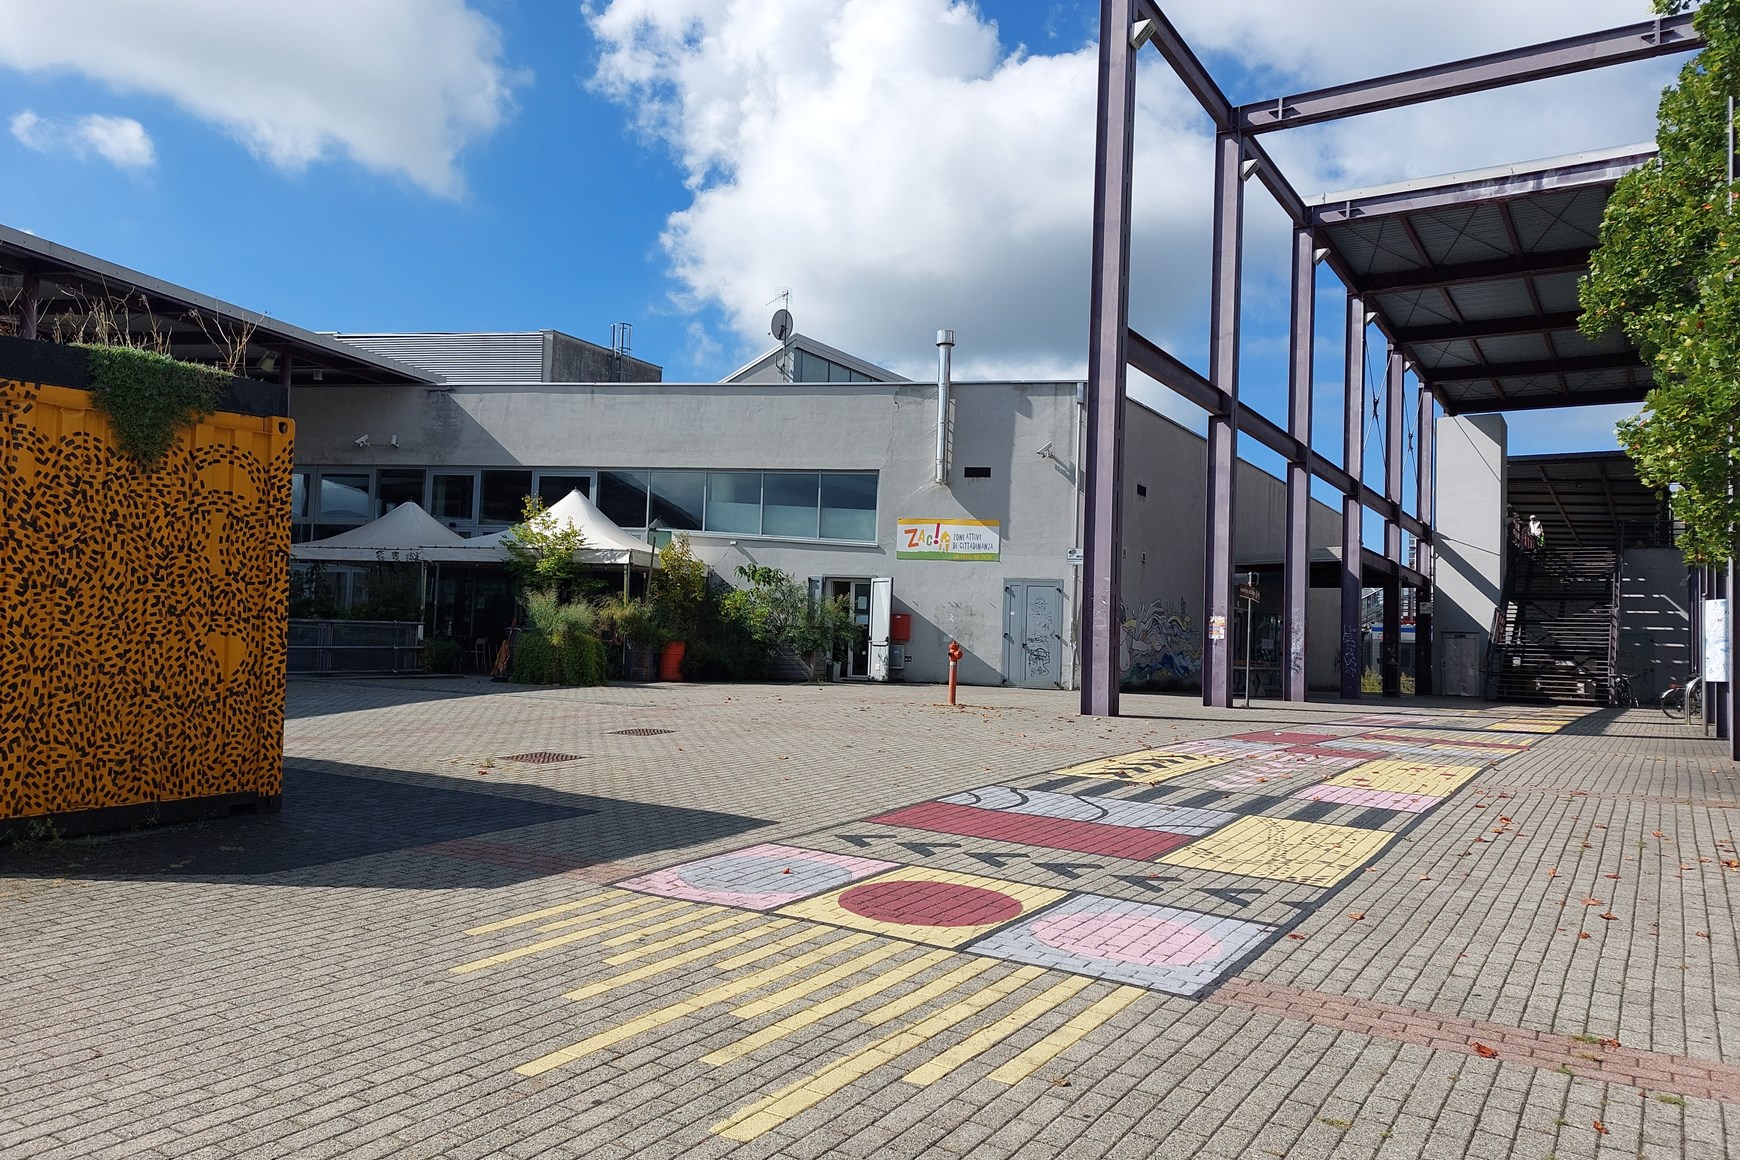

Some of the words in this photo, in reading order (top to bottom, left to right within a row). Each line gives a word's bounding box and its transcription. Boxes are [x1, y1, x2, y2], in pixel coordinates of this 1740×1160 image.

[904, 523, 941, 548] ZAC!
[953, 533, 965, 541] ZONE
[965, 532, 982, 541] ATTIVE
[952, 542, 958, 550] DI
[959, 541, 994, 551] CITTADINANZA
